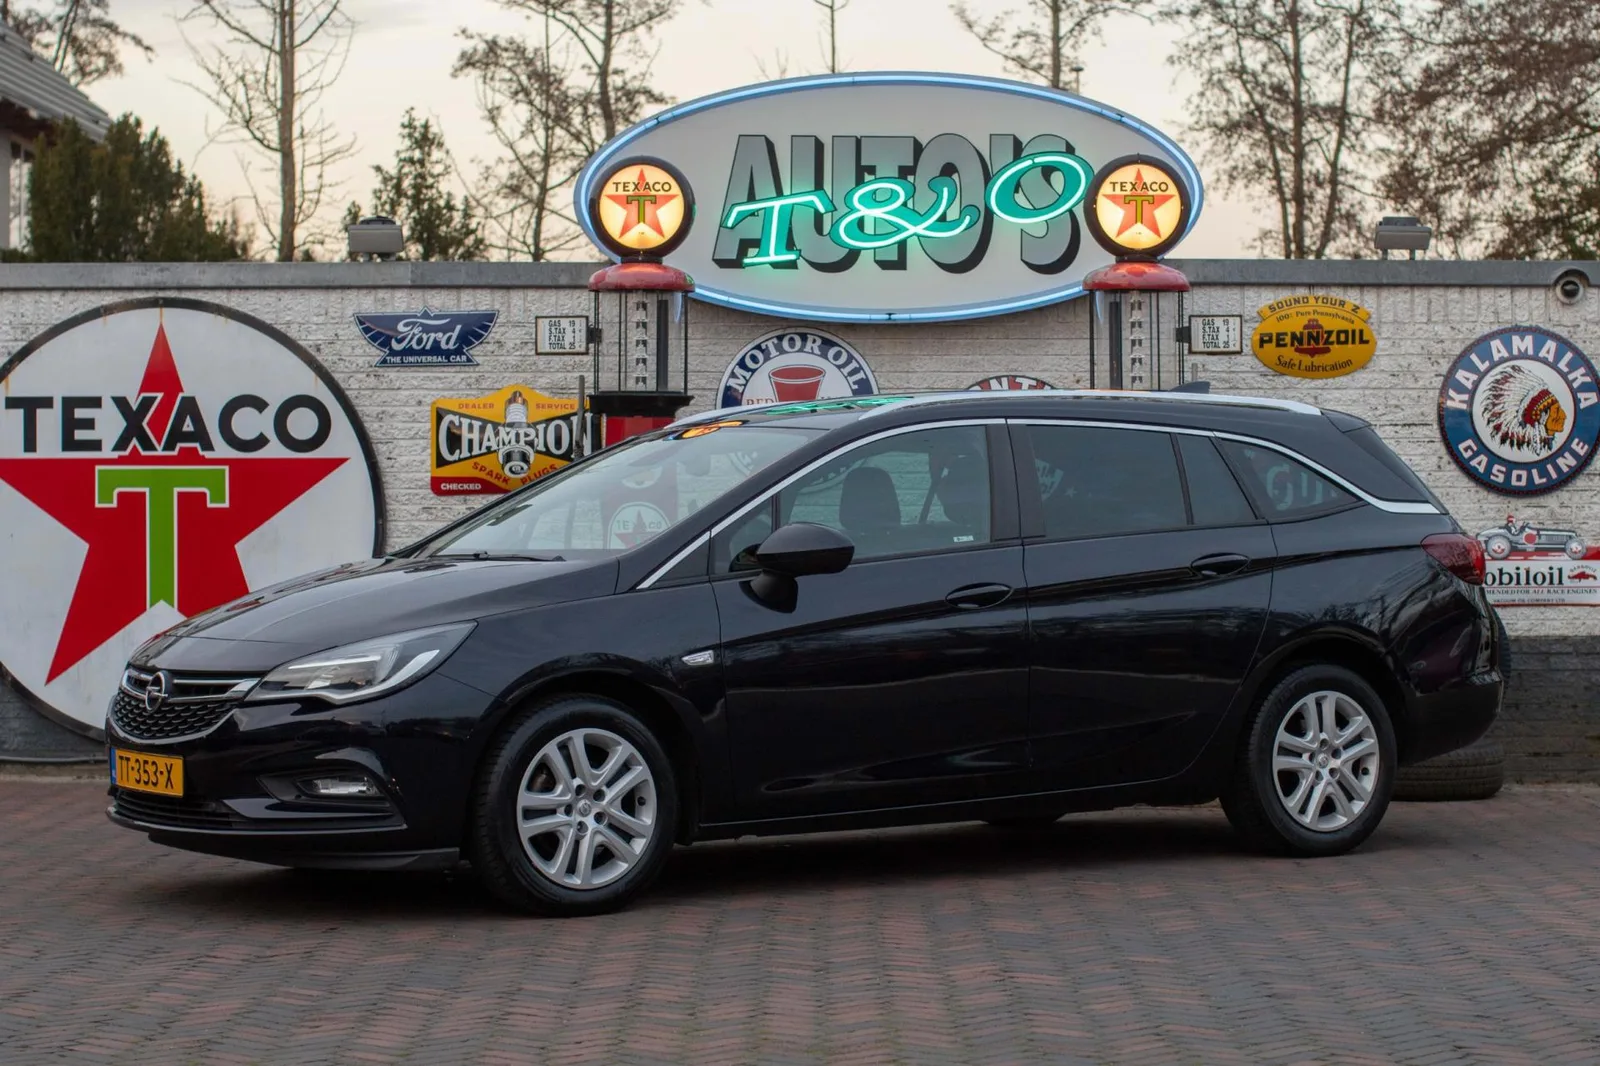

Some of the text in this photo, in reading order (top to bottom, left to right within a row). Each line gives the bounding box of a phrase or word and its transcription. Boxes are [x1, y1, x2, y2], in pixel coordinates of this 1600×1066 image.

[612, 182, 672, 192] TEXACO
[1110, 182, 1169, 192] TEXACO
[712, 133, 1080, 274] AUTO'S
[1268, 296, 1360, 314] SOUND YOUR Z
[548, 320, 561, 328] GAS
[1312, 309, 1355, 325] Pennsylvania
[391, 318, 462, 351] Ford
[548, 327, 567, 335] S.TAX
[1259, 329, 1370, 348] PENNZOIL
[1202, 341, 1221, 349] TOTAL
[727, 333, 867, 393] MOTOR OIL
[1275, 355, 1353, 373] Safe Lubrication
[1446, 335, 1599, 410] KALAMALKA
[5, 394, 332, 453] TEXACO
[438, 412, 593, 462] CHAMPION
[1458, 438, 1589, 487] GASOLINE
[472, 461, 558, 485] SPARK PLUGS
[1484, 566, 1564, 586] obiloil
[119, 755, 174, 789] TT-353-X
